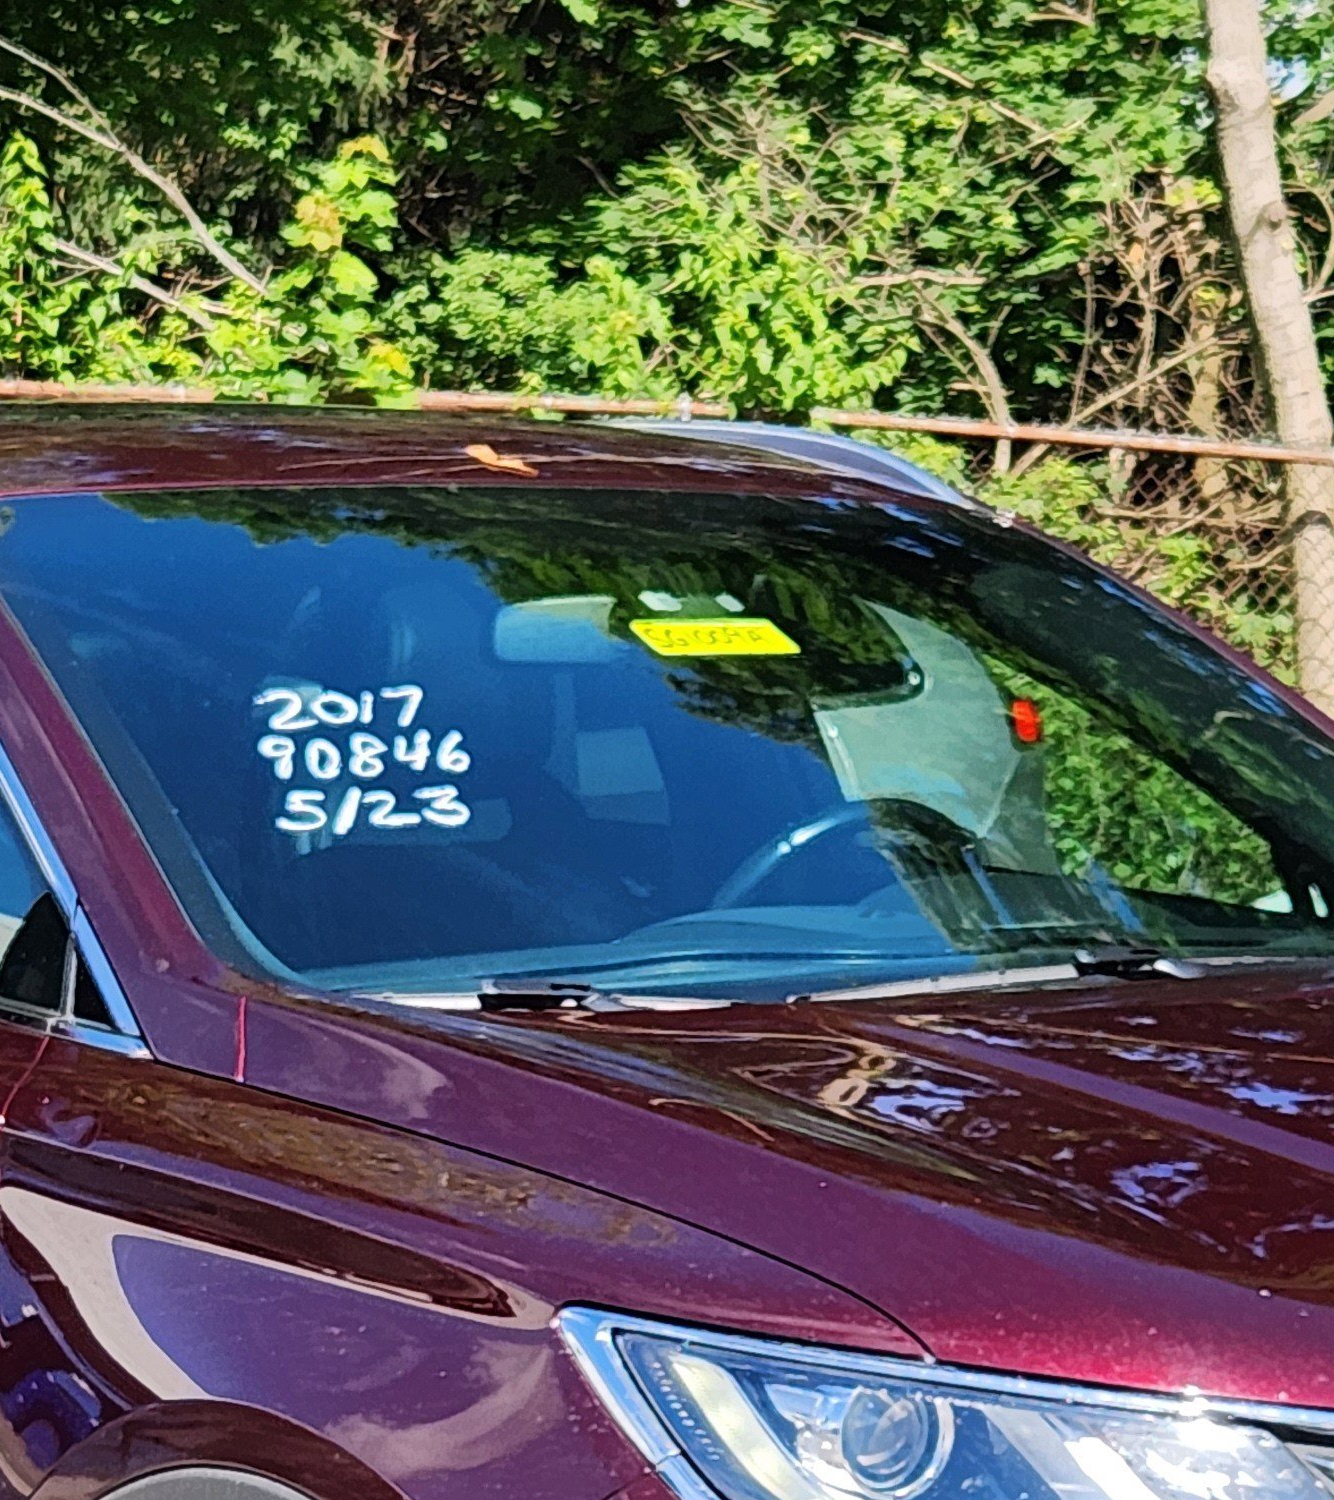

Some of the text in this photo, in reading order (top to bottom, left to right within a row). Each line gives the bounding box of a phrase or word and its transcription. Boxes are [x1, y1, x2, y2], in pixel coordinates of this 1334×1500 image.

[253, 684, 423, 730] 2017
[257, 729, 470, 780] 90846
[274, 784, 470, 835] 5/23
